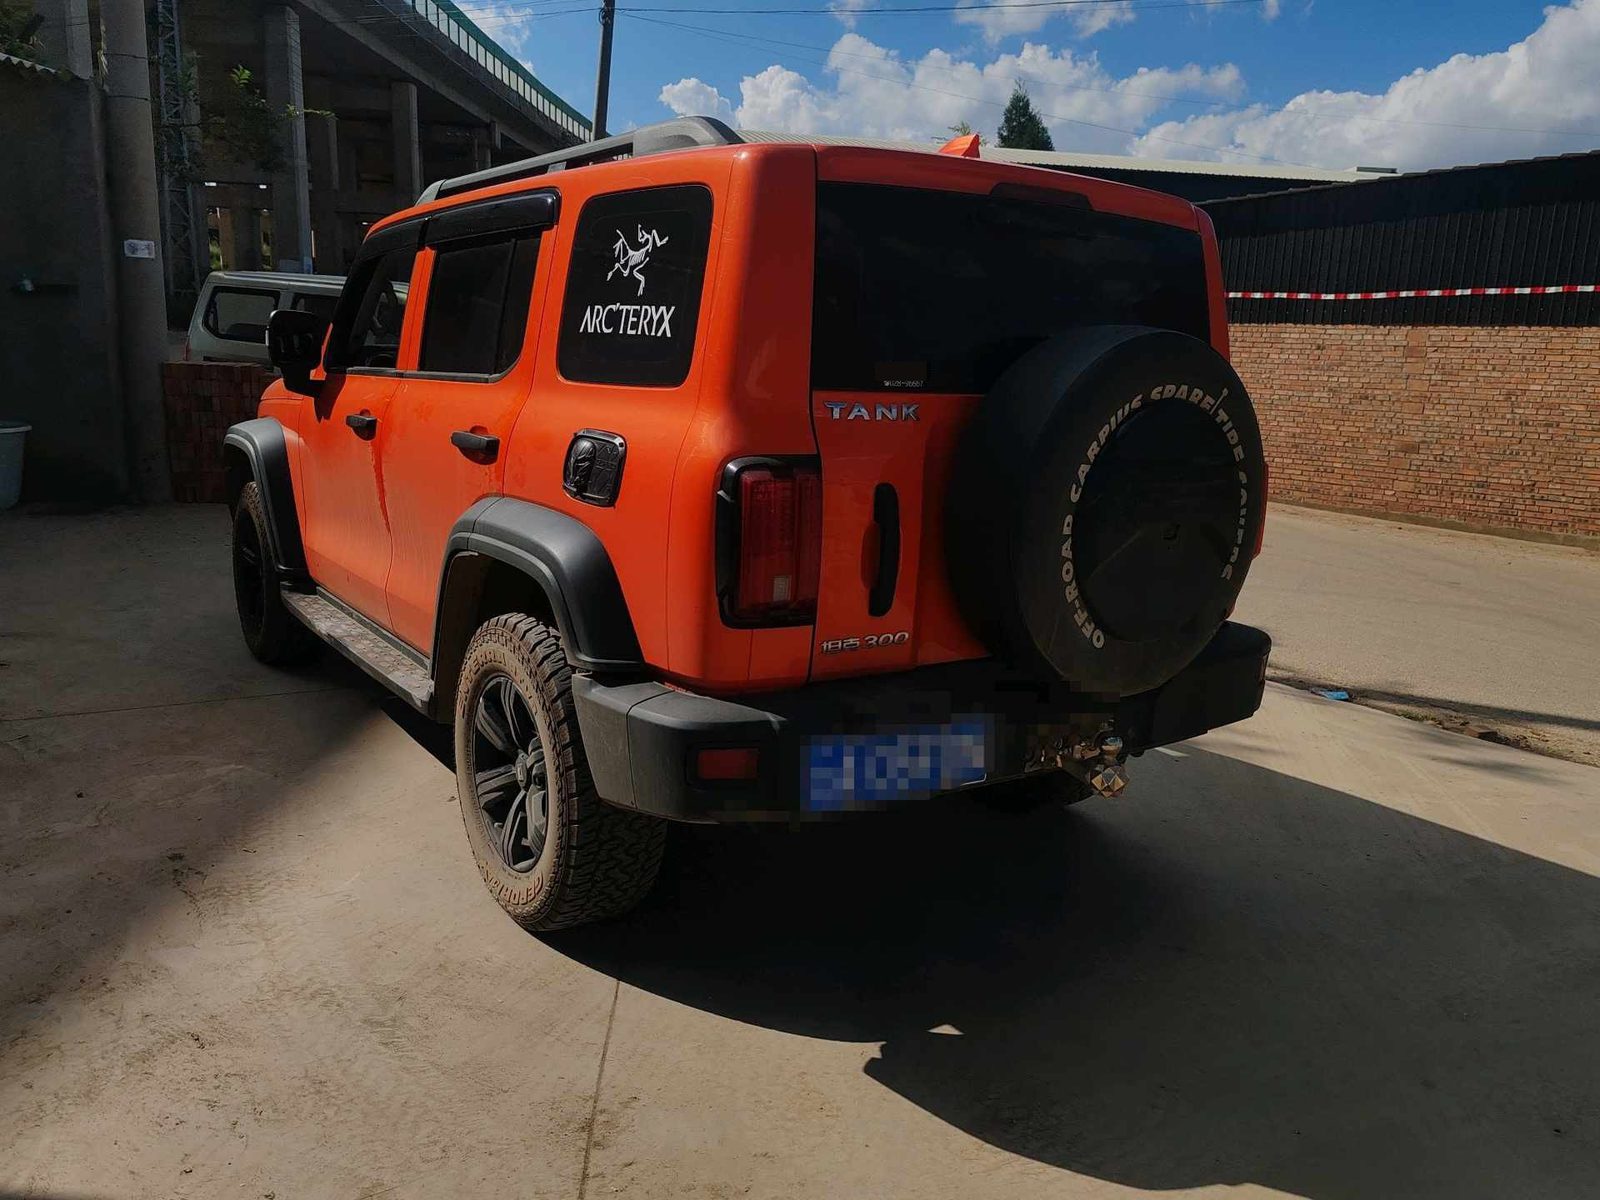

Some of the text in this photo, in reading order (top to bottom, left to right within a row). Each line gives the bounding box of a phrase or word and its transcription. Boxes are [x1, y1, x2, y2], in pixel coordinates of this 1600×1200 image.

[579, 302, 676, 338] ARC'TERYX
[823, 401, 921, 422] TANK
[1061, 514, 1106, 649] OFF-ROAD
